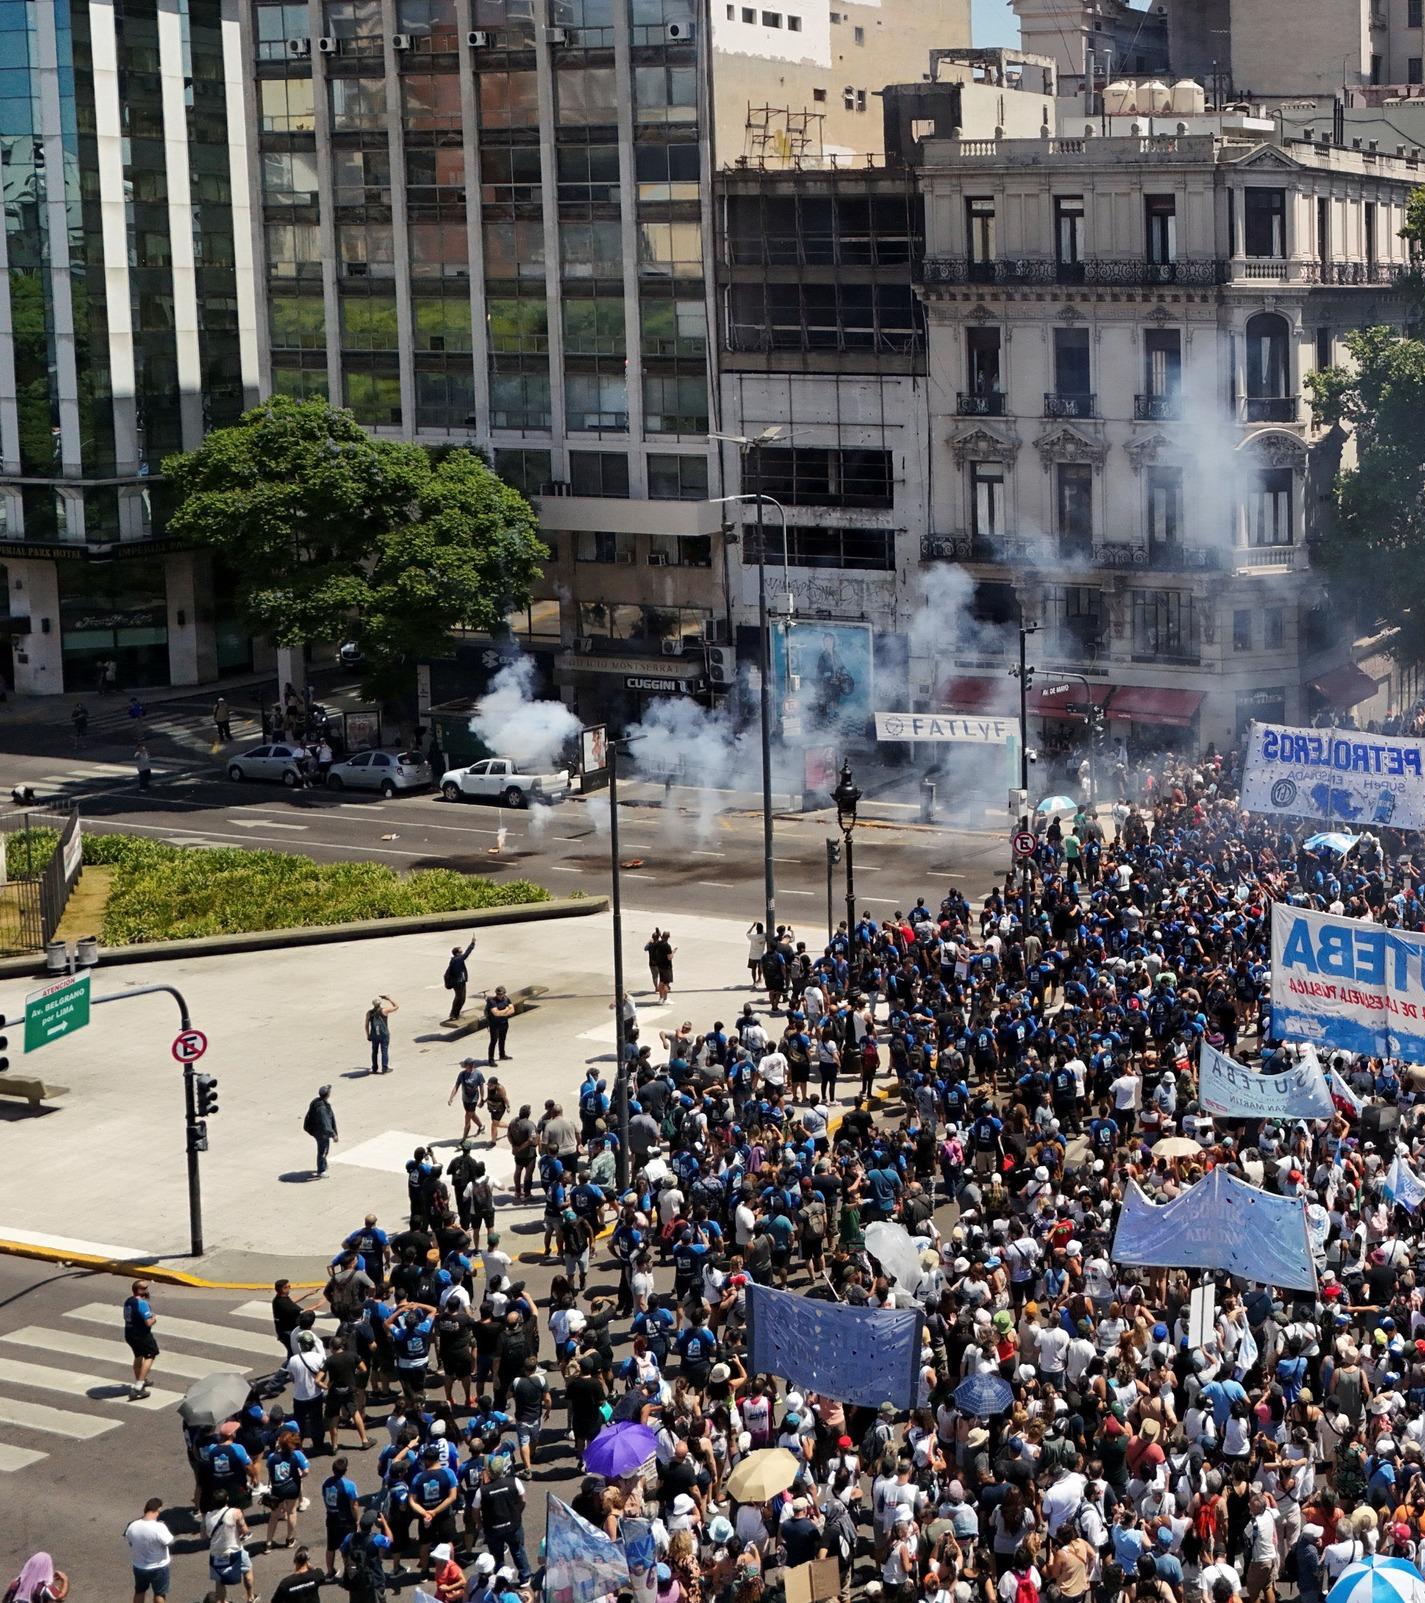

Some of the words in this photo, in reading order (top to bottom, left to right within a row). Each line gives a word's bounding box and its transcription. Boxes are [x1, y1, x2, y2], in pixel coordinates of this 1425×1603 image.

[626, 677, 676, 692] CUGGINI
[1050, 687, 1056, 695] DE
[1056, 684, 1070, 694] MAYO
[912, 718, 1006, 741] FATLyF
[42, 976, 76, 996] ATENCIÓN
[31, 1008, 43, 1018] Av.
[45, 987, 85, 1012] BELGRANO
[41, 1014, 54, 1026] por
[56, 1005, 75, 1018] LIMA
